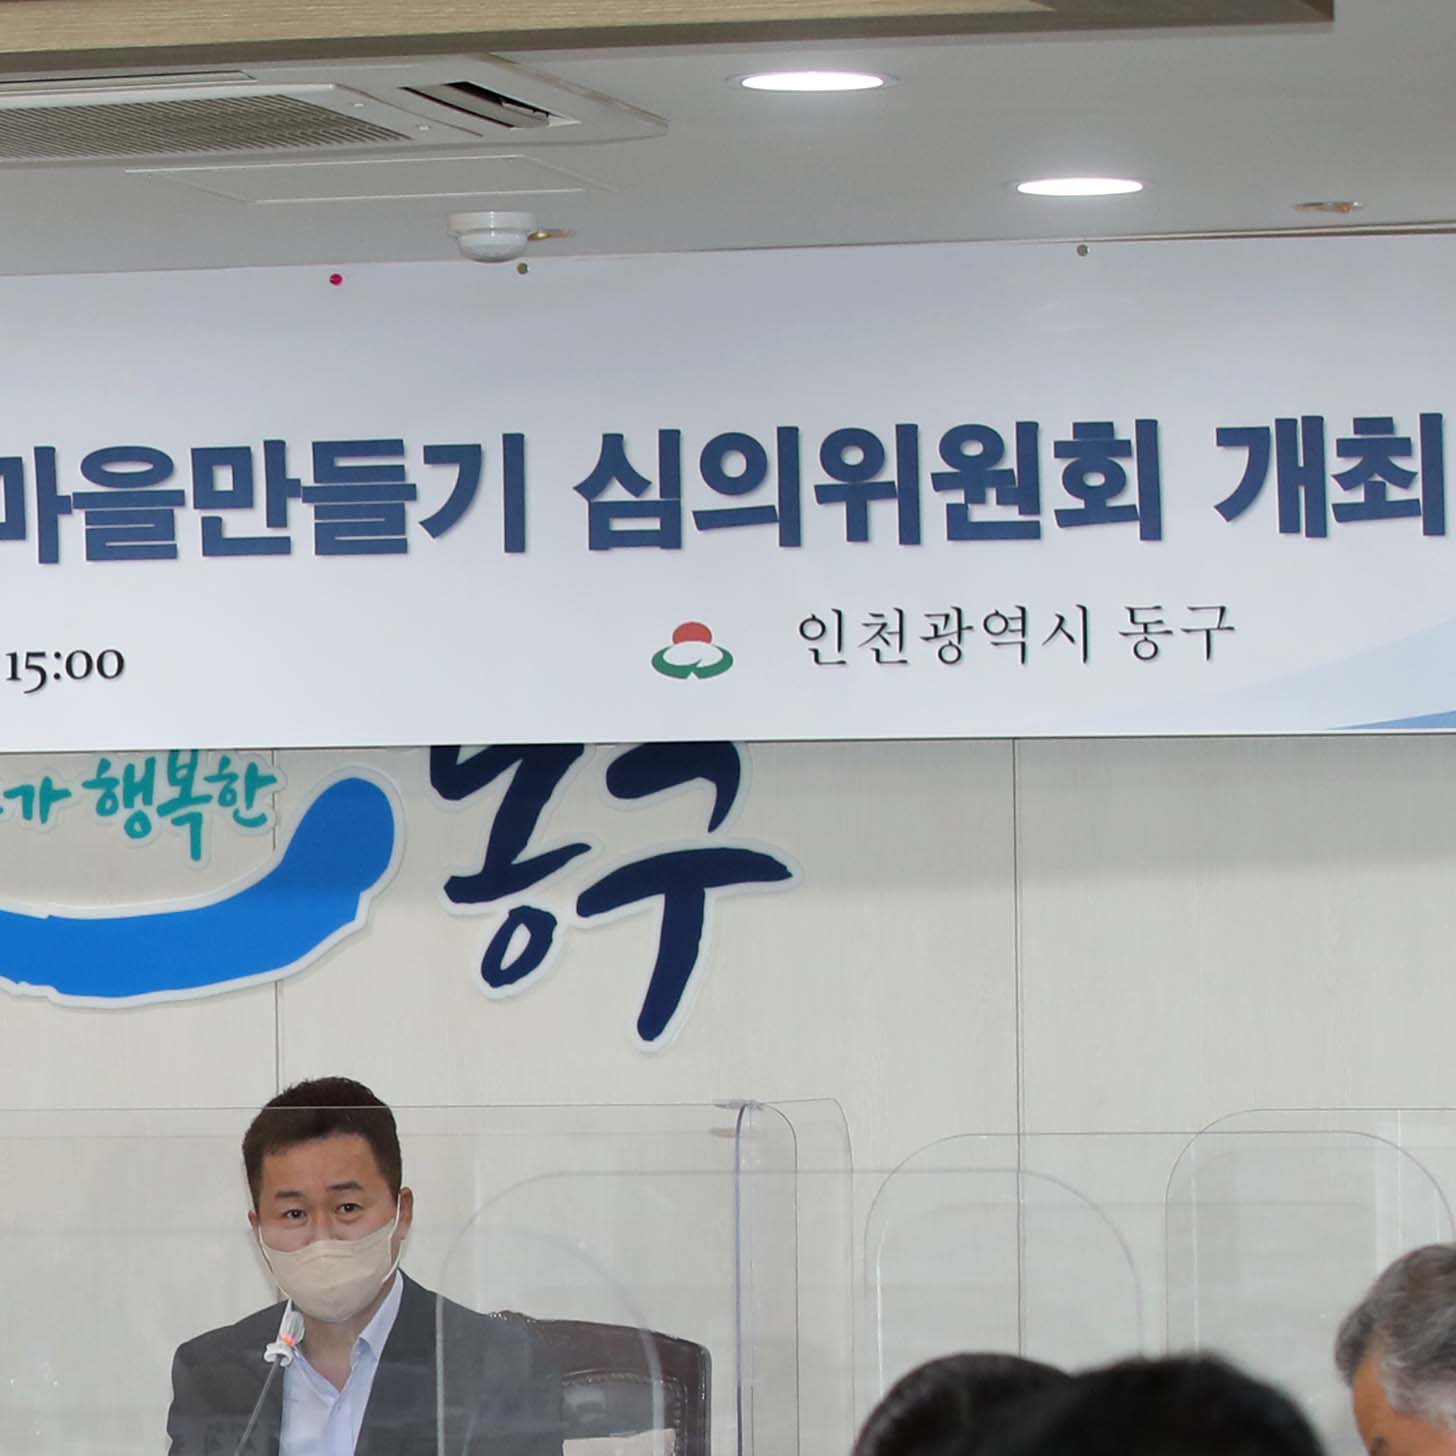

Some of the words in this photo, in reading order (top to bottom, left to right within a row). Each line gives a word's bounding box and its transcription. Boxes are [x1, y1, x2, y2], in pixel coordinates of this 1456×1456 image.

[572, 418, 1164, 552] 심의위원회
[1213, 412, 1448, 540] 개최
[6, 649, 126, 694] 15:00
[798, 604, 1091, 667] 인천광역시
[1118, 604, 1236, 662] 동구
[83, 748, 277, 863] 행복한
